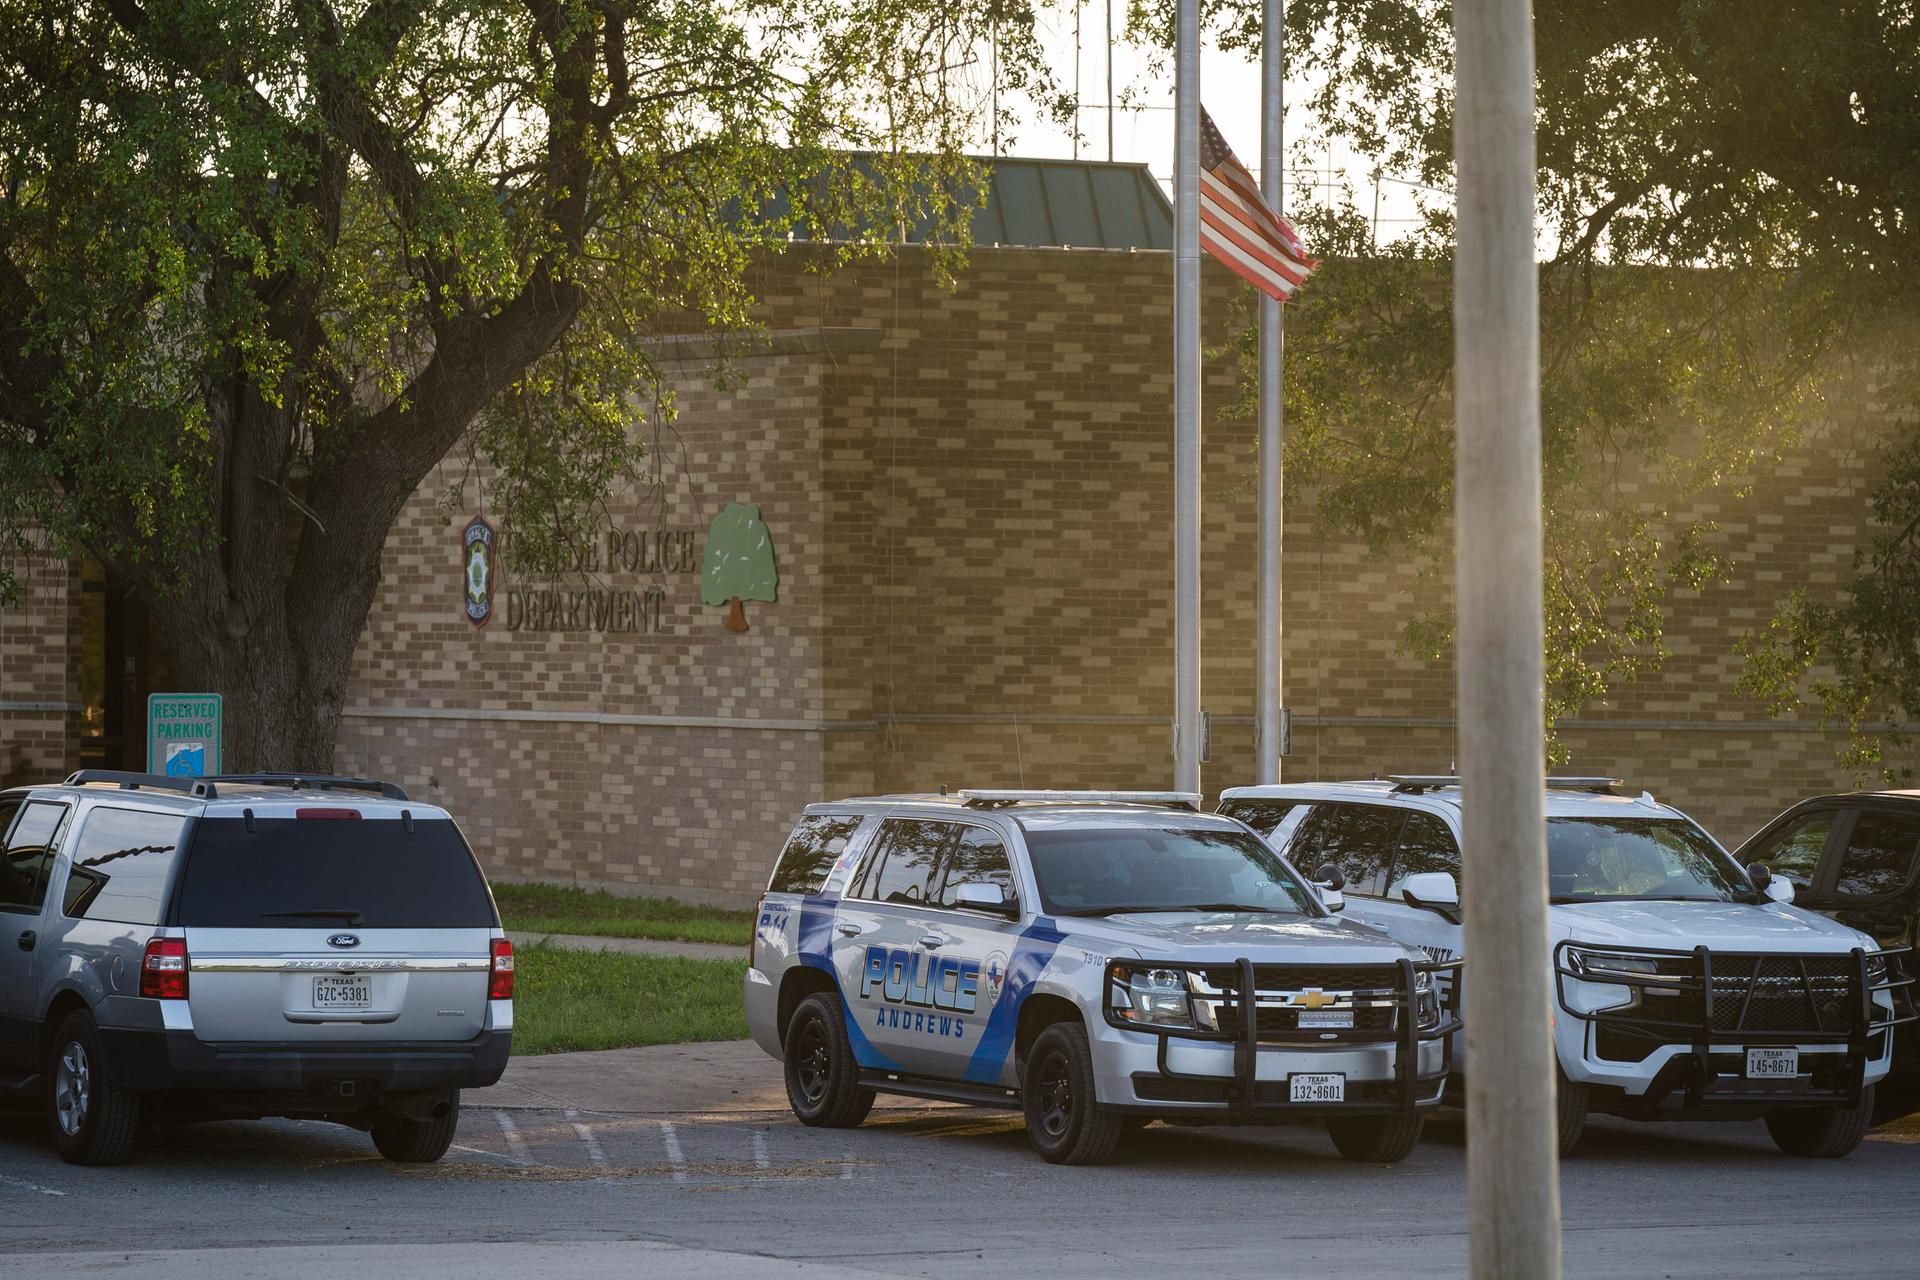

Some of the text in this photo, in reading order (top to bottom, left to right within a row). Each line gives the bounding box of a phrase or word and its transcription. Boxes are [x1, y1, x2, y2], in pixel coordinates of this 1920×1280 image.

[606, 531, 697, 574] POLICE
[506, 590, 666, 633] DEPARTMENT
[154, 703, 217, 719] RESERVED
[157, 722, 213, 738] PARKING
[335, 936, 355, 945] Ford
[282, 960, 408, 969] EXPEDITION
[860, 944, 980, 1015] POLICE
[876, 1007, 965, 1039] ANDREWS
